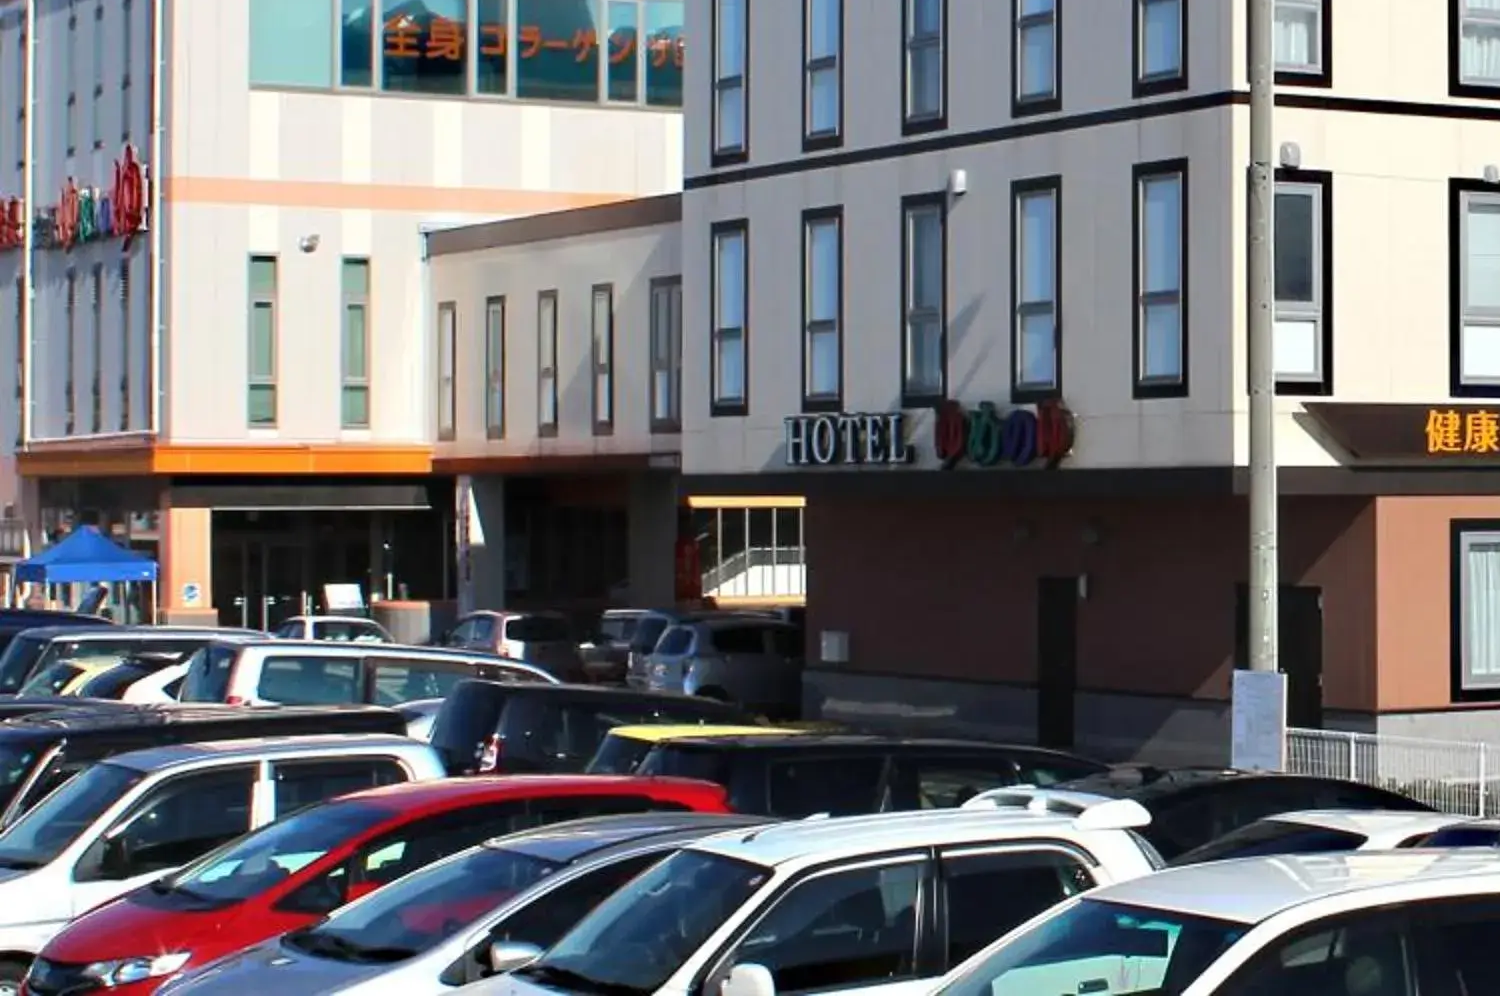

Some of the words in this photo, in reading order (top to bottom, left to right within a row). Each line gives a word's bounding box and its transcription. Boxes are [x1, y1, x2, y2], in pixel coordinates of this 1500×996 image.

[784, 413, 908, 465] HOTEL
[934, 400, 1075, 470] ゆめのゆ
